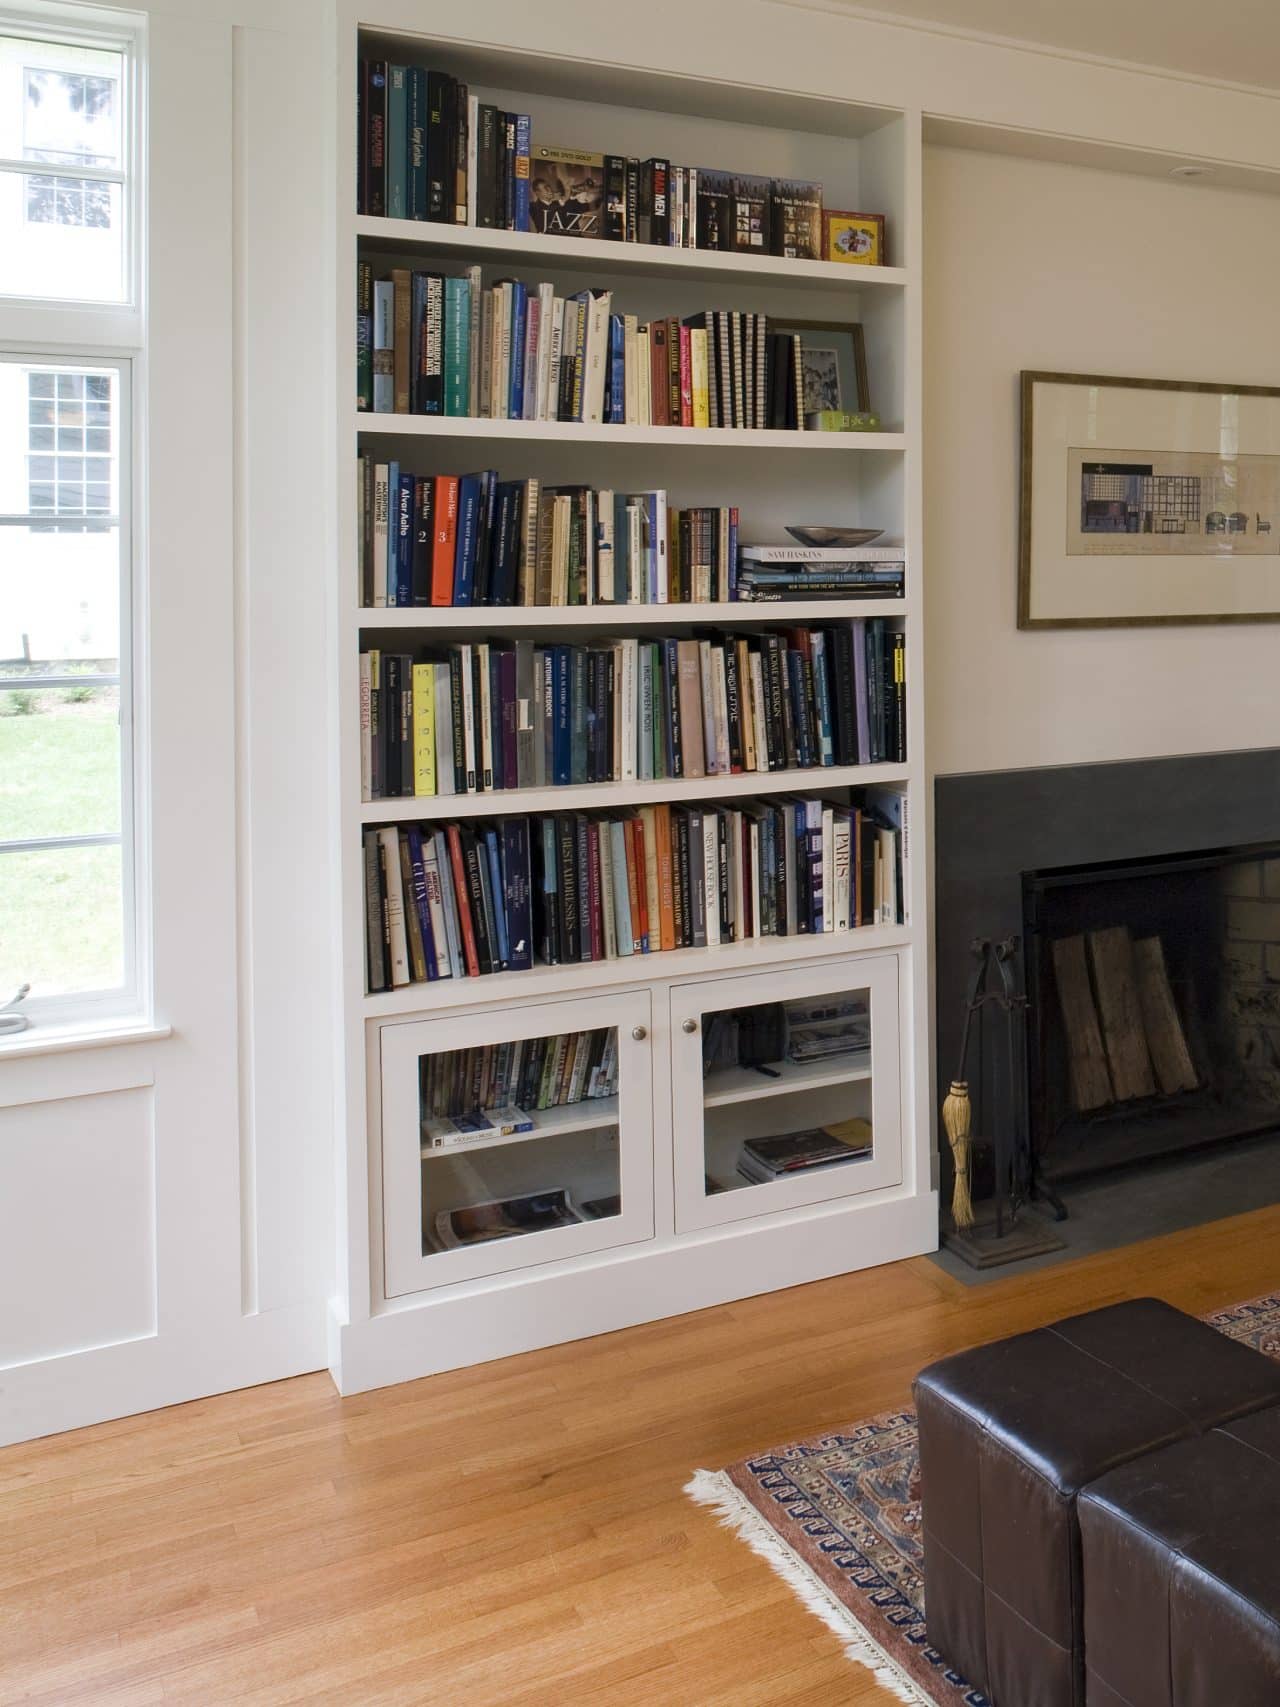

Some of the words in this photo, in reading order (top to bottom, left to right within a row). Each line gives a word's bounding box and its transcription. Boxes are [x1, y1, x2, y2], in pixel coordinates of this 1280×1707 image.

[516, 157, 528, 177] JAZZ
[654, 170, 665, 194] MAD
[654, 194, 666, 217] MEN
[543, 209, 598, 234] JAZZ
[576, 304, 586, 346] TOWARDS
[551, 327, 561, 358] AMERICAN
[575, 357, 583, 376] NEW
[572, 379, 581, 417] MUSEUM
[400, 488, 410, 512] Alvar
[400, 512, 410, 536] Aalto
[417, 530, 426, 543] 2
[438, 531, 447, 544] 3
[767, 551, 786, 560] SAM
[544, 656, 552, 685] ANTOINE
[770, 649, 779, 674] HOME
[727, 668, 736, 694] WRIGHT
[361, 677, 370, 730] LEGORRETA
[545, 687, 553, 717] PREDOCK
[728, 696, 738, 722] STYLE
[772, 686, 782, 717] DESIGN
[418, 669, 431, 777] STARCK
[561, 836, 574, 865] BEST
[579, 825, 588, 868] AMERICAN
[705, 831, 713, 853] NEW
[836, 832, 849, 879] PARIS
[412, 862, 427, 900] CUBA
[431, 871, 441, 905] AMERICAN
[581, 875, 589, 891] ARTS
[562, 866, 576, 930] ADDRESSES
[663, 883, 671, 910] HOUSE
[582, 899, 591, 927] CRAFTS
